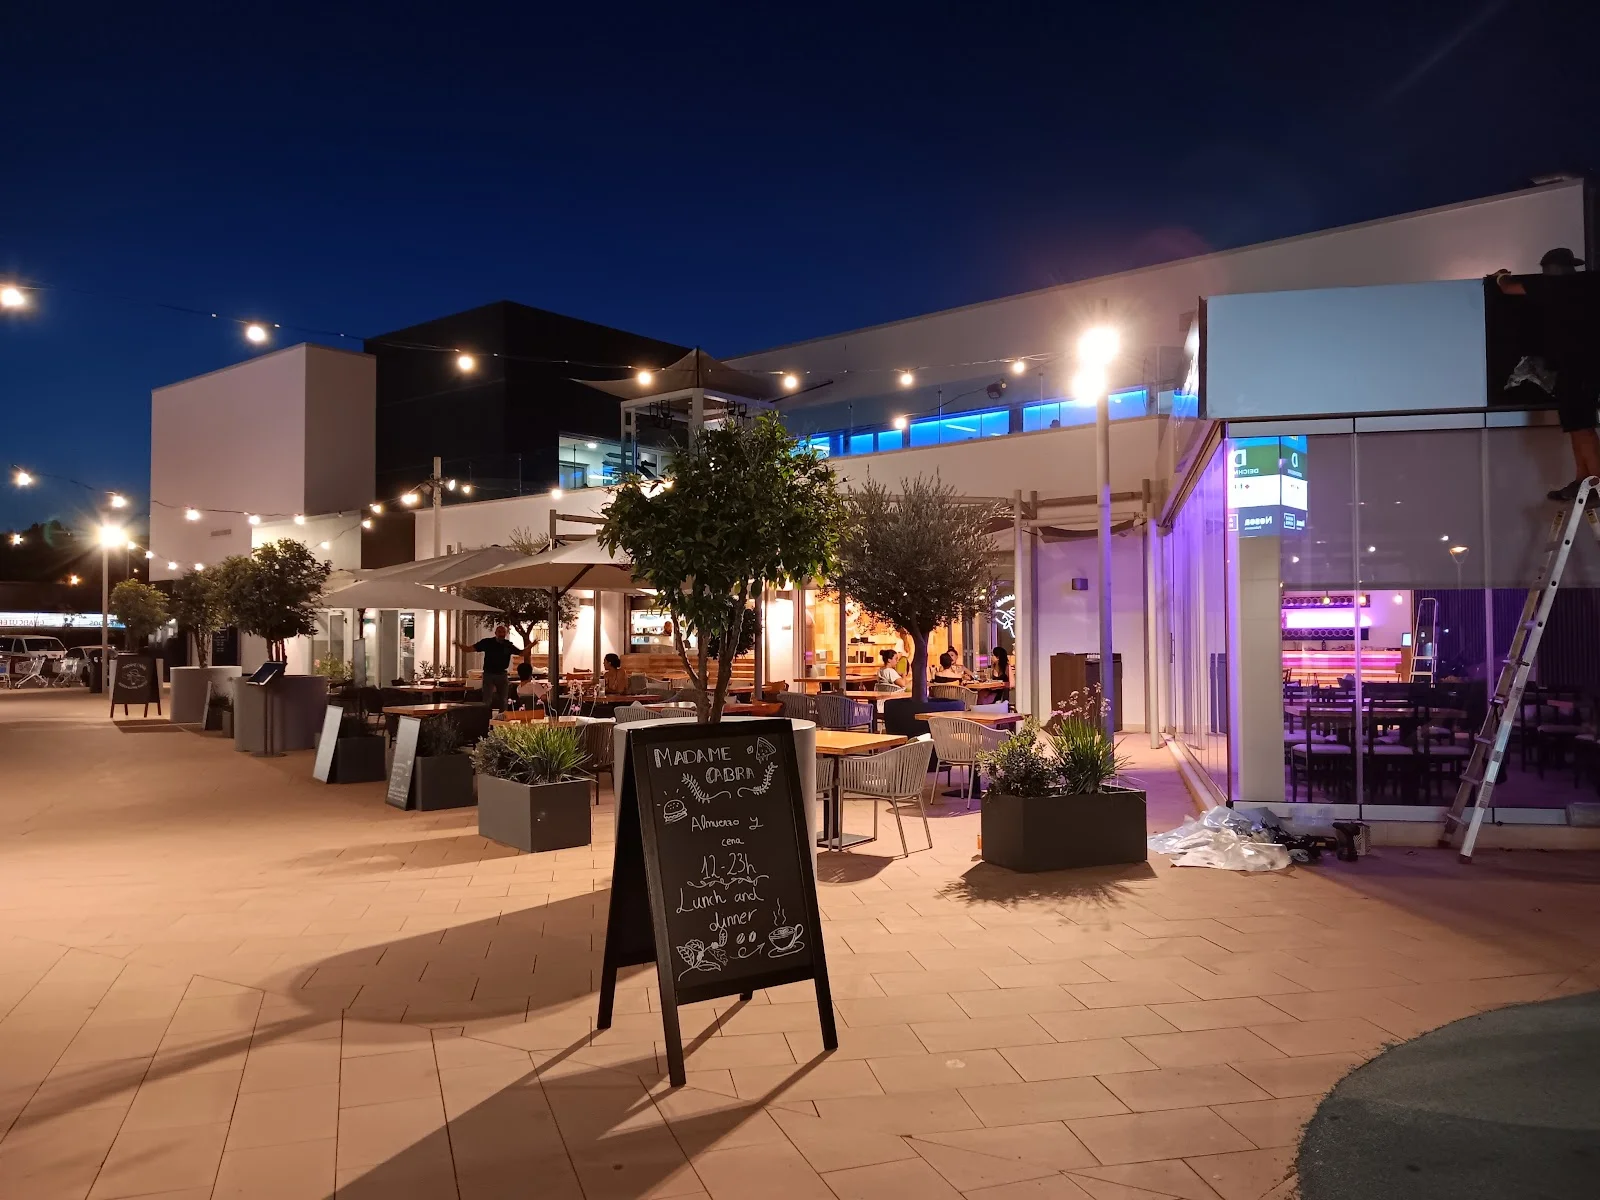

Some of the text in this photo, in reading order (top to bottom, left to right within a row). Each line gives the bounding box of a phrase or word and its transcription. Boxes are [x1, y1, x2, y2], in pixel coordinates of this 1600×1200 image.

[653, 746, 732, 768] MADAME
[705, 766, 755, 784] CABRA
[691, 815, 740, 832] Almuerzo
[721, 838, 745, 847] cena
[676, 887, 764, 914] Lunch and
[709, 909, 758, 932] dinner
